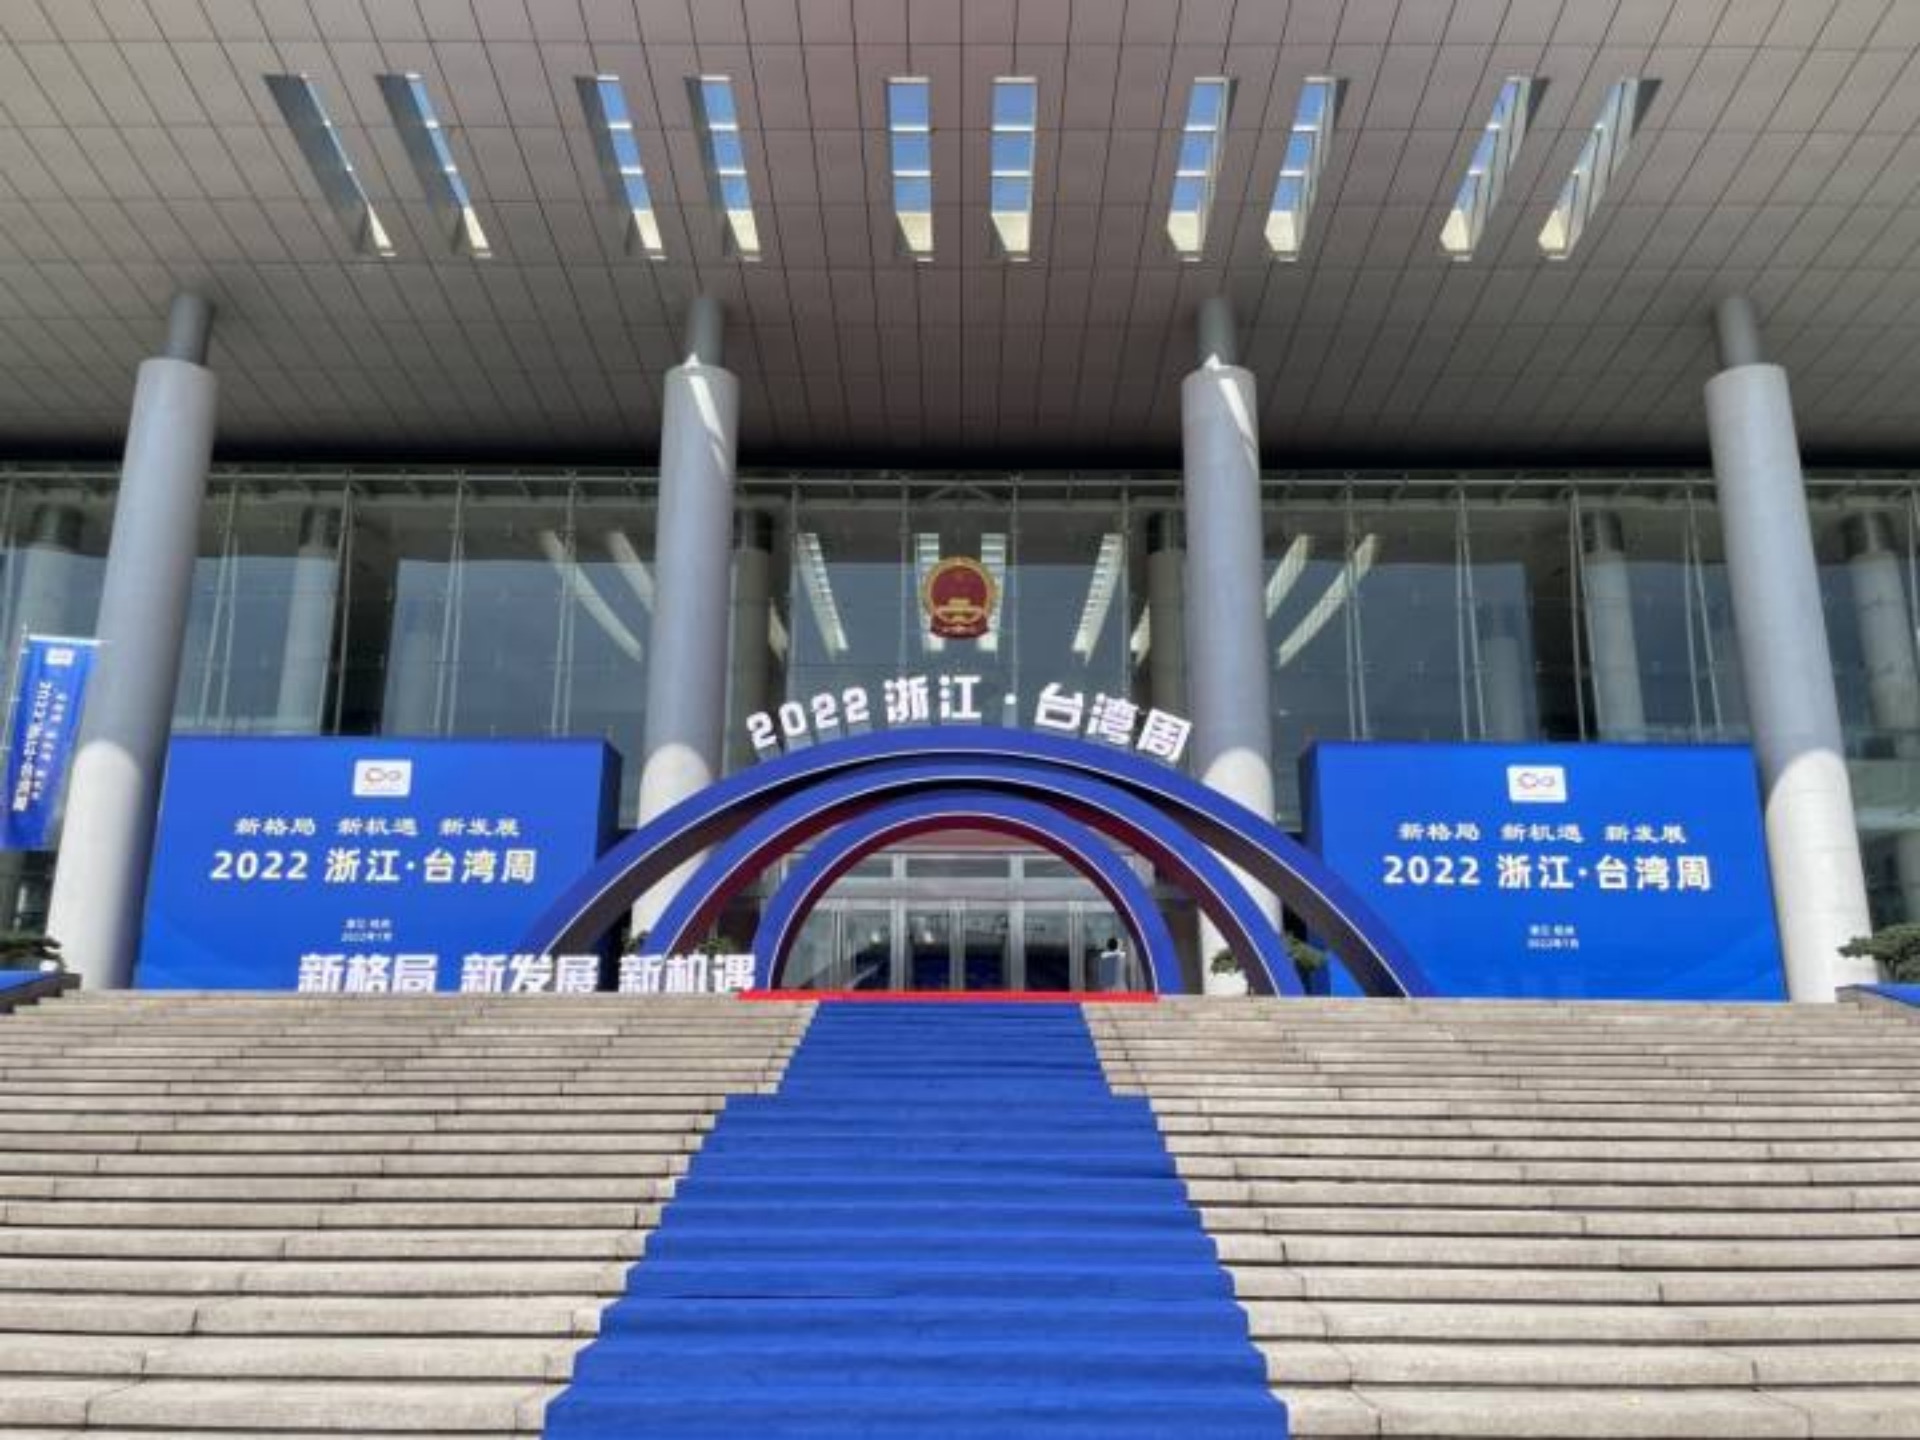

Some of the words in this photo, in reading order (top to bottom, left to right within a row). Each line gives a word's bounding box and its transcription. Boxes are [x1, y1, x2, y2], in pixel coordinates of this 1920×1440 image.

[746, 686, 870, 749] 2022
[235, 817, 316, 836] 新格局
[1399, 822, 1480, 841] 新格局
[211, 850, 309, 880] 2022
[1384, 855, 1480, 885] 2022
[297, 953, 437, 991] 新格局
[460, 953, 599, 991] 新发展
[618, 952, 756, 991] 新机遇
